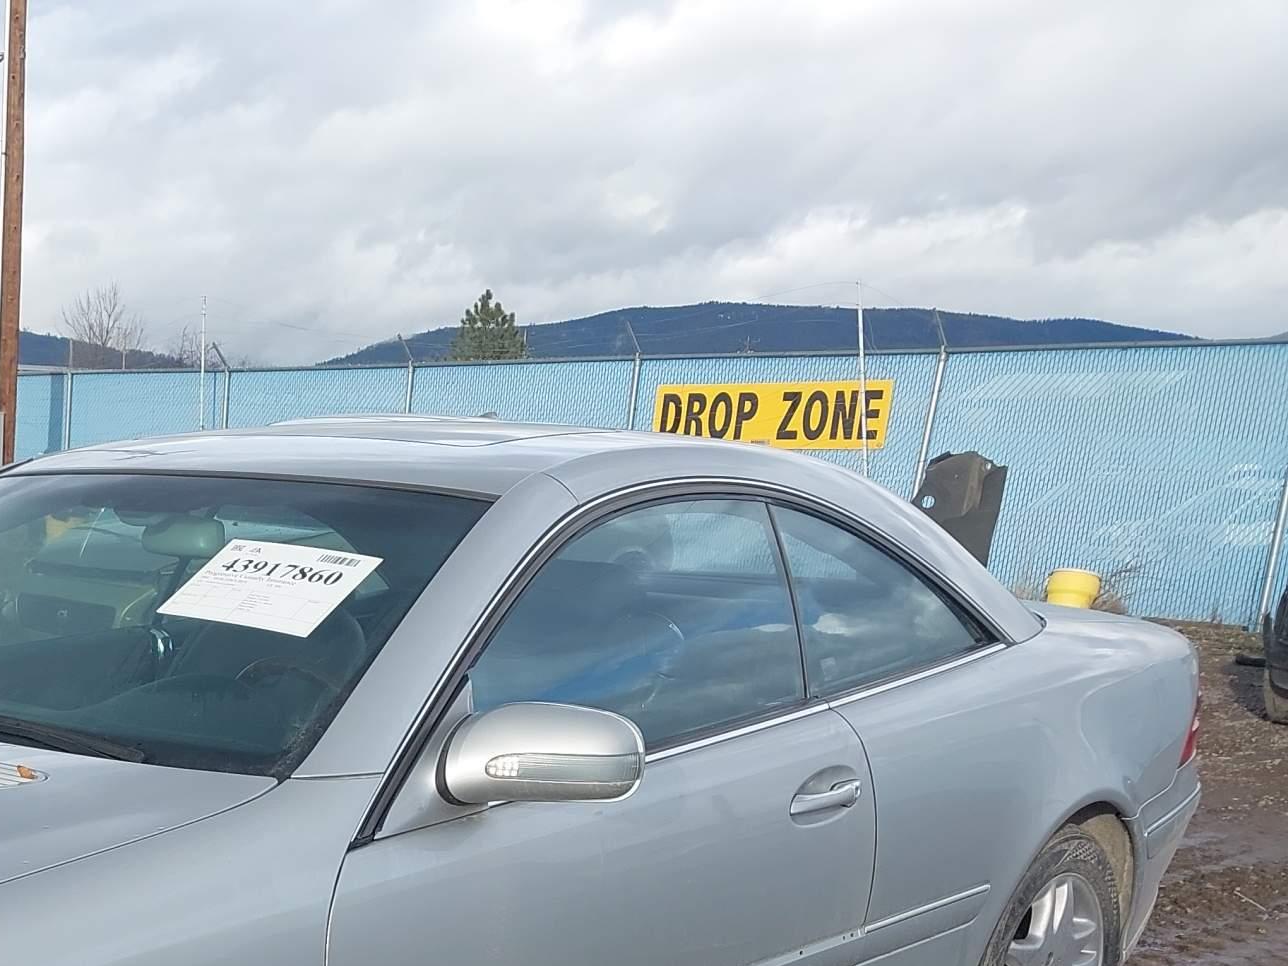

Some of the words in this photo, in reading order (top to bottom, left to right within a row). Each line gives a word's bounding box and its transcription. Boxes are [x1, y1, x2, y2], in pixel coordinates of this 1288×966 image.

[659, 391, 759, 440] DROP
[775, 389, 884, 441] ZONE
[221, 557, 344, 586] 43917860
